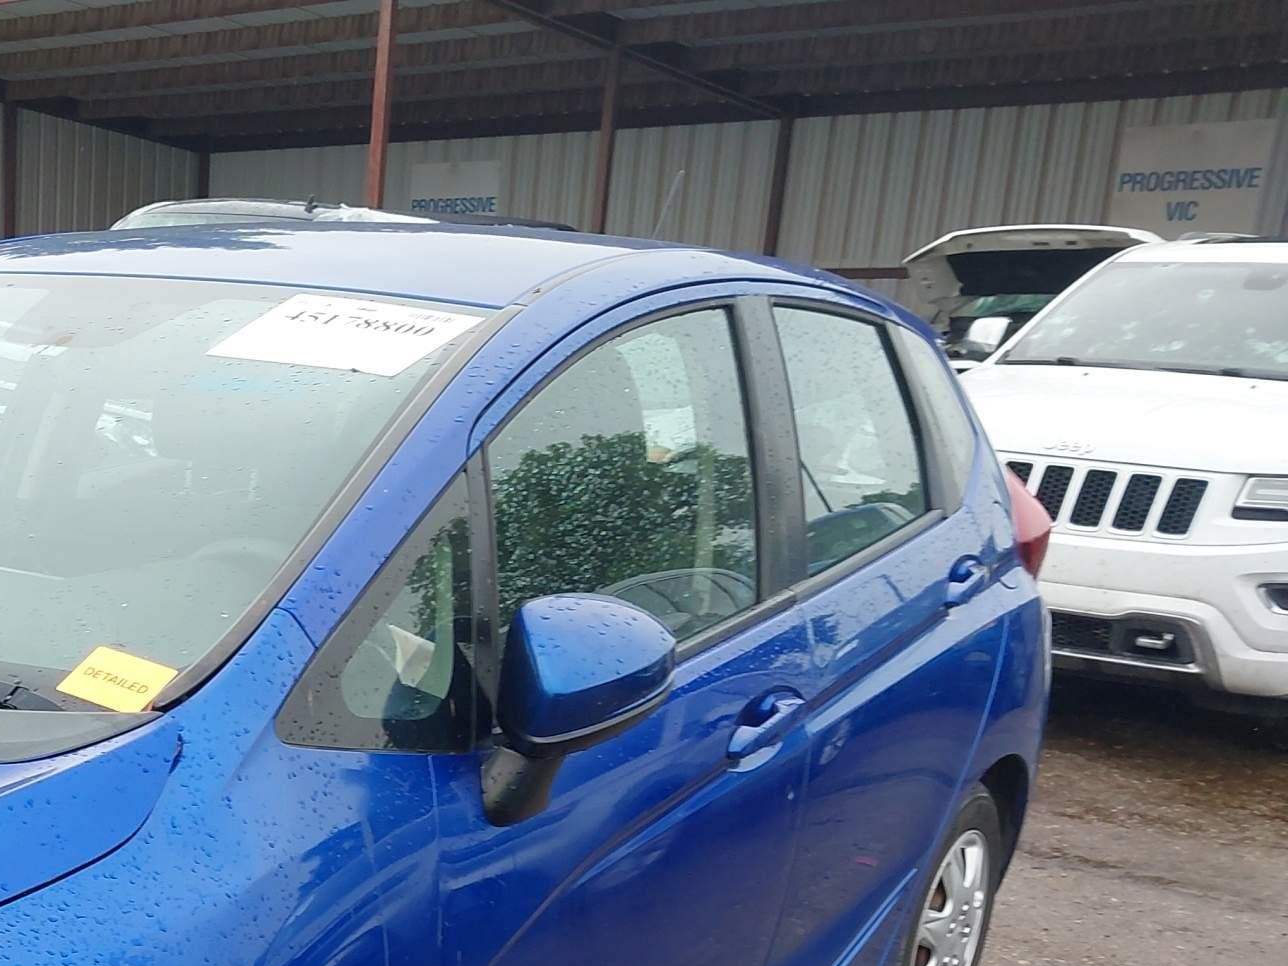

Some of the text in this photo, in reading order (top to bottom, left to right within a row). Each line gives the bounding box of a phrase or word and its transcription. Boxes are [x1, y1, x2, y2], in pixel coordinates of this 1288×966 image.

[1118, 168, 1263, 192] PROGRESSIVE
[411, 197, 497, 213] PROGRESSIVE
[1166, 201, 1200, 222] VIC
[82, 666, 150, 694] DETAILED
